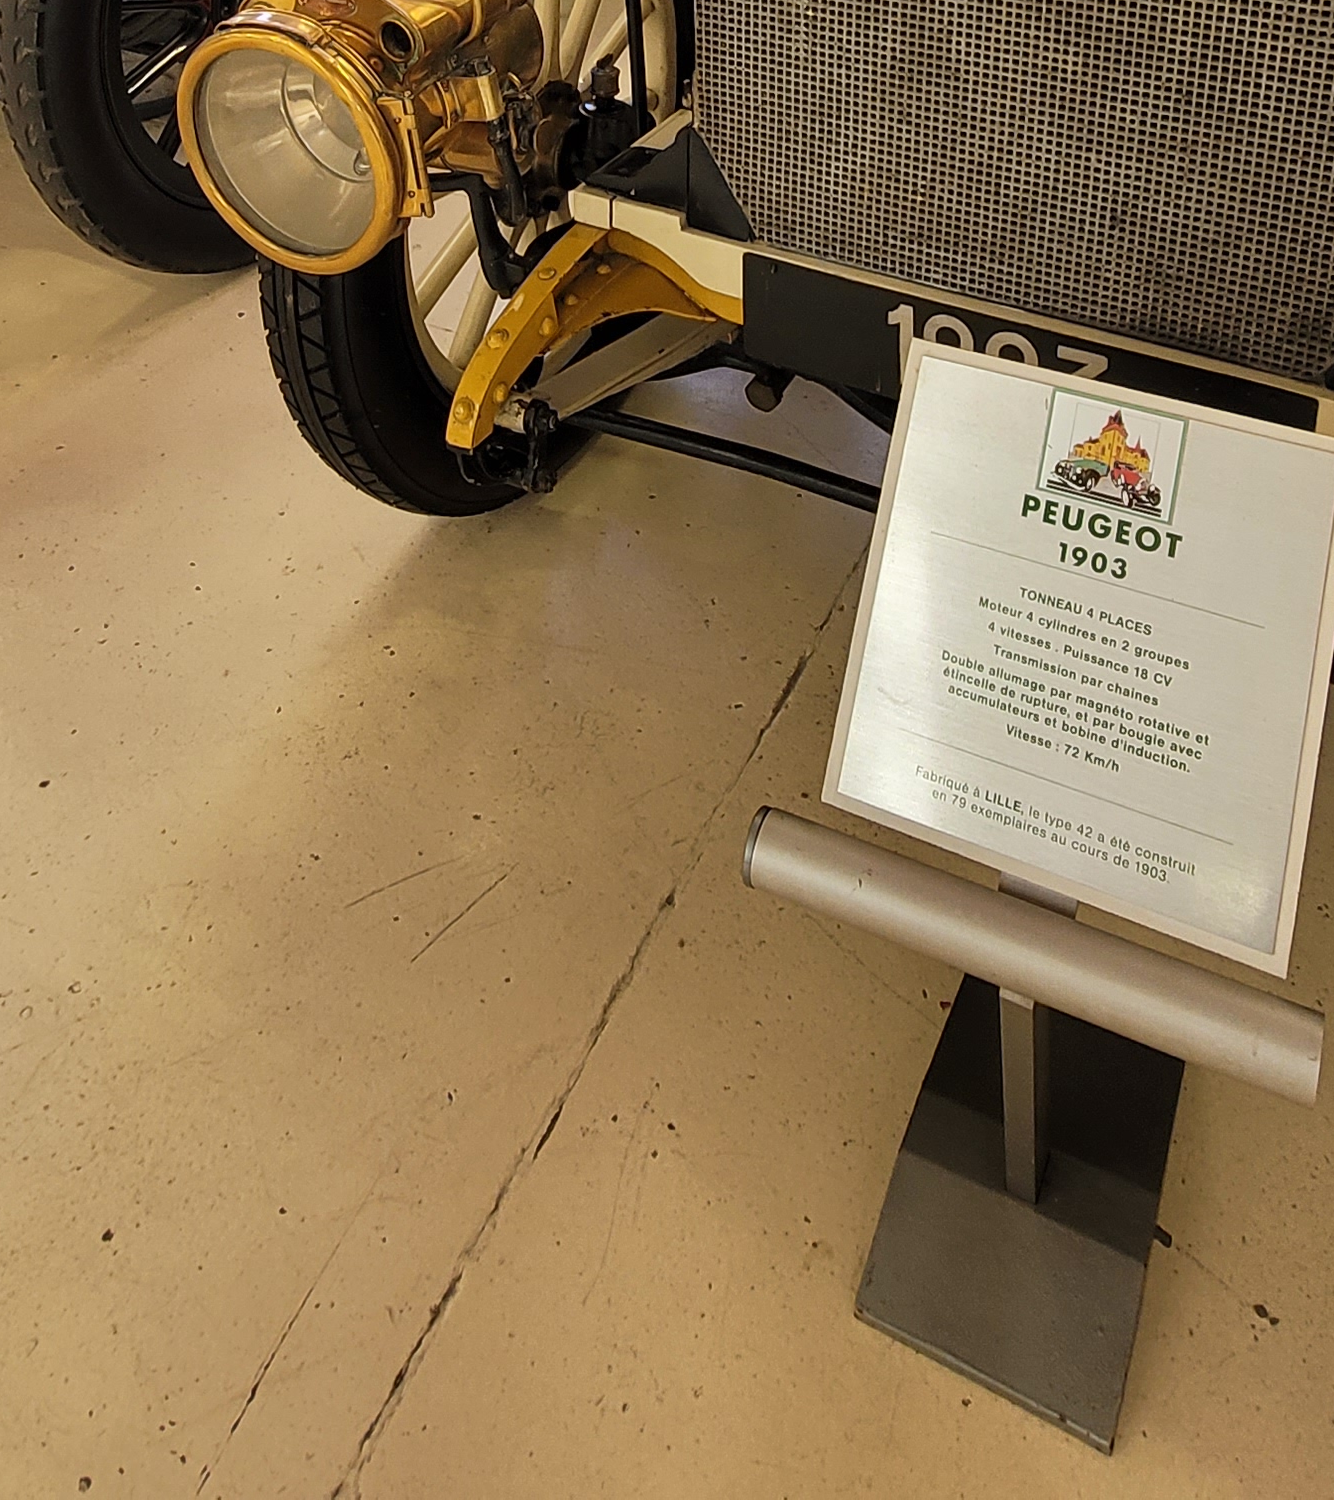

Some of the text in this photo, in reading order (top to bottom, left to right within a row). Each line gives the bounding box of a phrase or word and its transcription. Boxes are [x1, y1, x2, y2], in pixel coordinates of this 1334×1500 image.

[1021, 494, 1183, 559] PEUGEOT
[1058, 542, 1127, 579] 1903
[978, 596, 1190, 671] Moteur 4 cylindres en 2 groupes
[1019, 587, 1153, 636] TONNEAU 4 PLACES
[987, 622, 995, 633] 4
[999, 625, 1052, 651] vitesses
[1063, 644, 1129, 674] Puissance
[1134, 666, 1148, 680] 18
[1154, 672, 1173, 687] CV
[993, 644, 1159, 706] Transmission par chaines
[942, 649, 1209, 746] Double allumage par magnéto rotative et
[943, 665, 1202, 761] étincelle de rupture, et par bougie avec
[948, 684, 1191, 773] accumulateurs et bobine d'induction.
[1005, 723, 1052, 750] Vitesse
[1064, 744, 1080, 759] 72
[1084, 751, 1120, 773] Km/h
[915, 765, 1196, 876] Fabriqué à LILLE, le type 42 a été construit
[931, 789, 1170, 884] en 79 exemplaires au cours de 1903.
